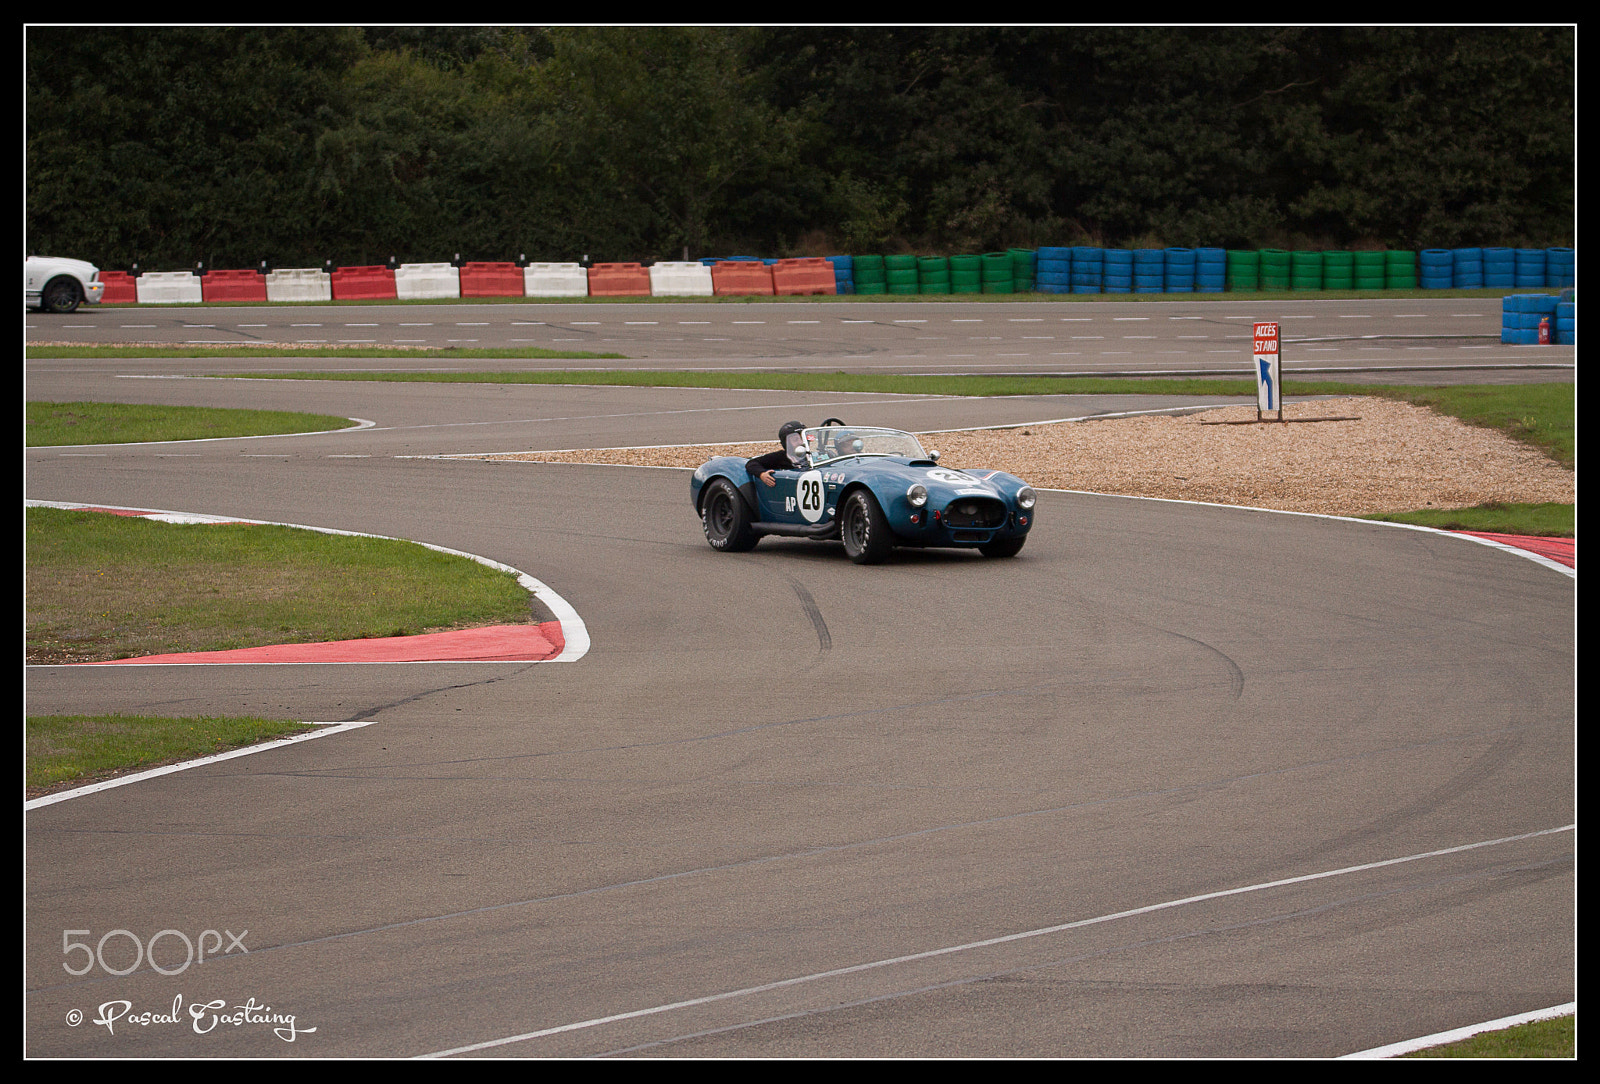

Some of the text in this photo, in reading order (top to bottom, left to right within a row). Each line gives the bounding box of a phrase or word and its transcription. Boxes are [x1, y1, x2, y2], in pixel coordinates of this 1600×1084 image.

[1254, 340, 1277, 352] STAND
[802, 480, 820, 510] 28
[785, 496, 796, 512] AP
